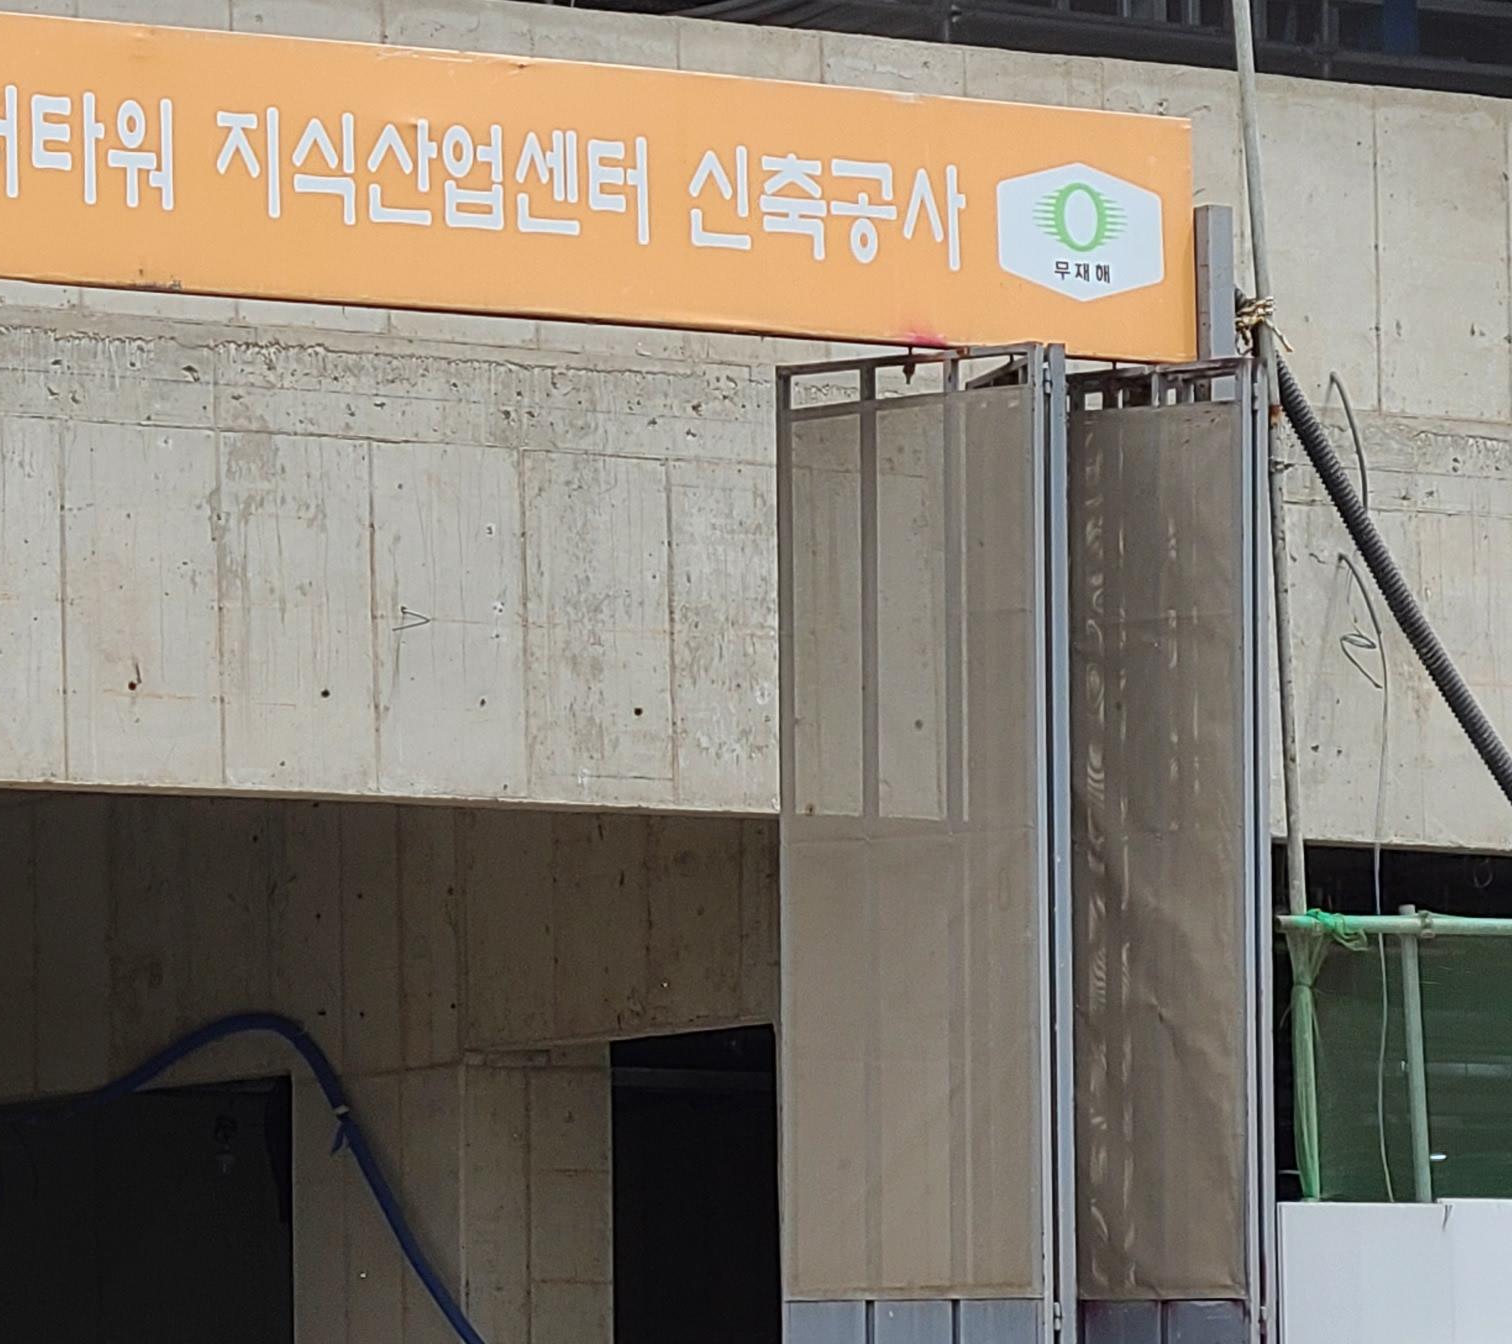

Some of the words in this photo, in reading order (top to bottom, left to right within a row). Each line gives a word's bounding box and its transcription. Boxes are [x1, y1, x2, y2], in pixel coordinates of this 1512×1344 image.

[216, 106, 650, 245] 지식산업센터
[688, 145, 966, 271] 신축공사
[1053, 259, 1112, 284] 무재해
